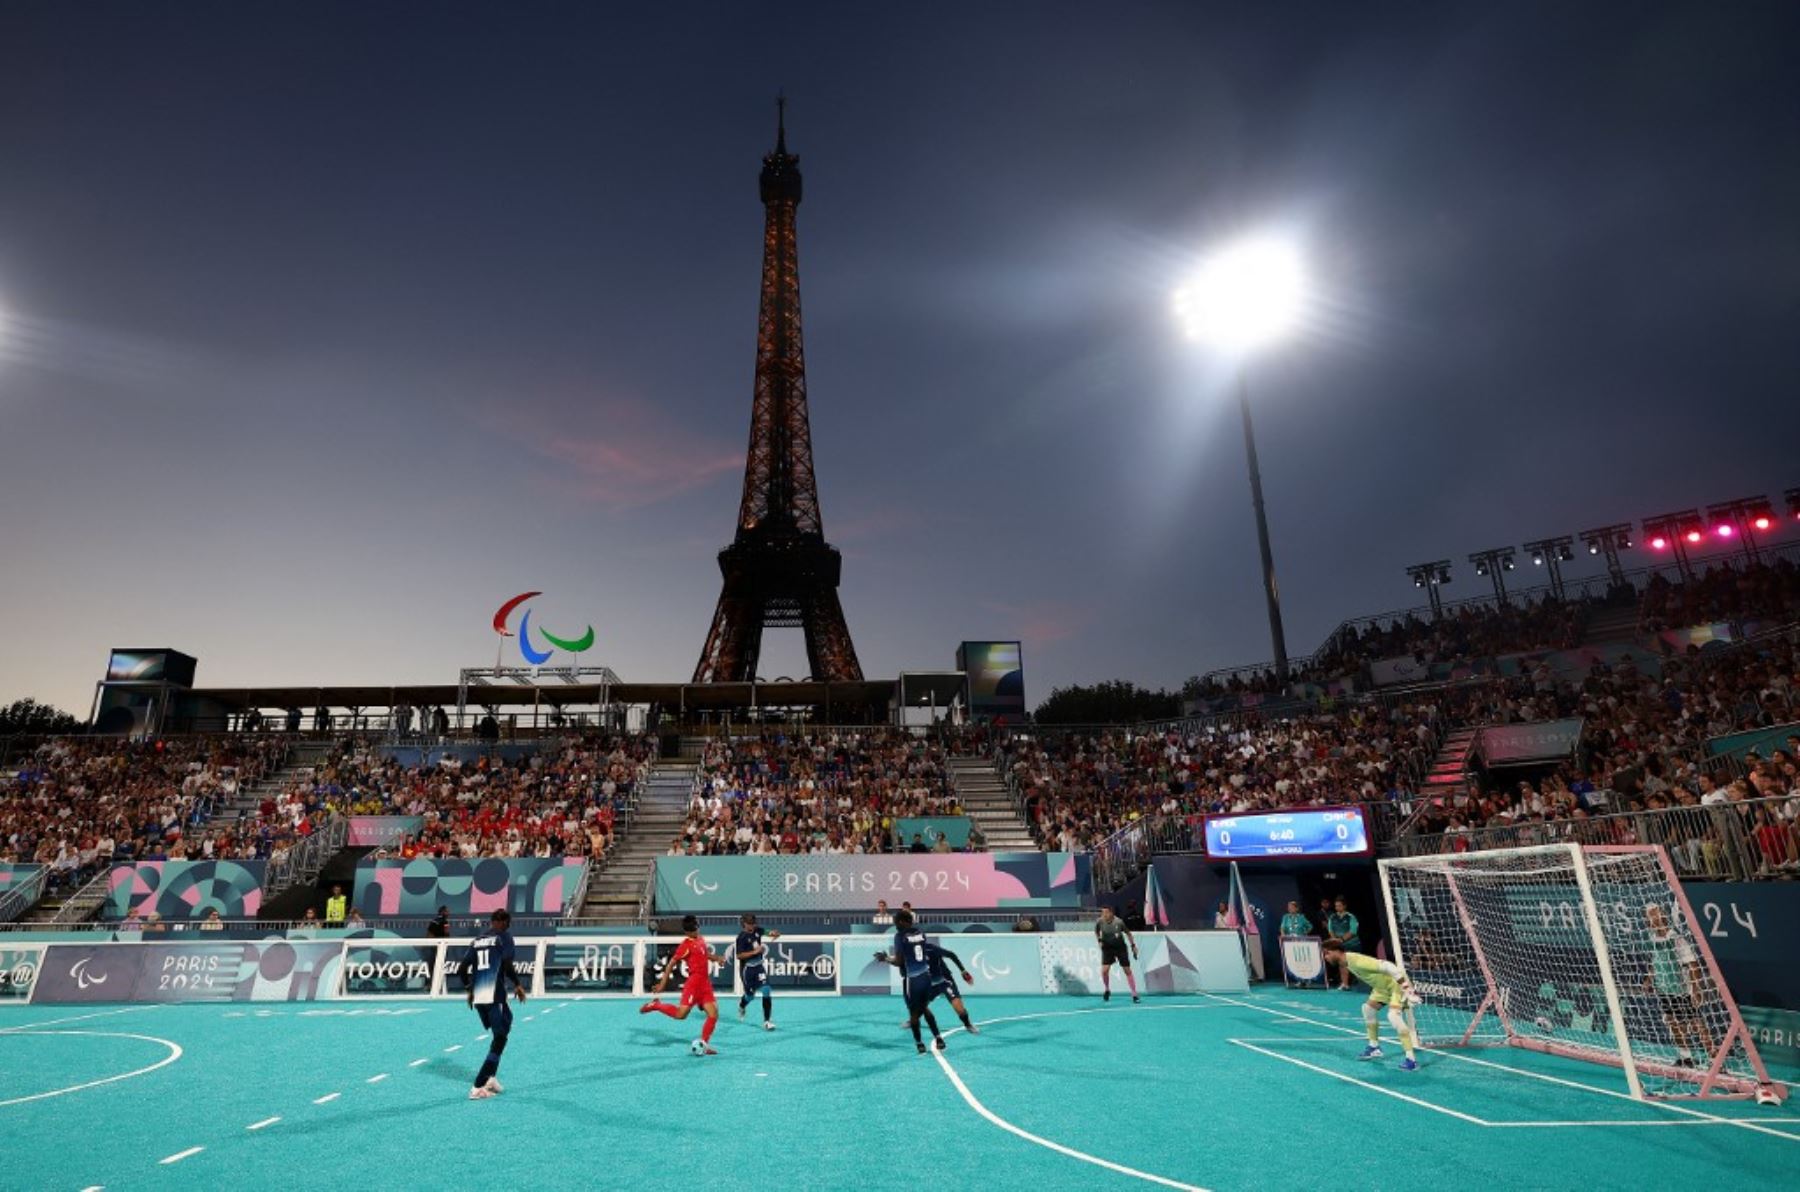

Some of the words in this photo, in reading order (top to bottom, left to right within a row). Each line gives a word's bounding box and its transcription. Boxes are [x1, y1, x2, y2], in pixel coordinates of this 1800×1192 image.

[1221, 831, 1231, 845] 0
[1270, 829, 1294, 841] 6:40
[1336, 823, 1348, 840] 0
[889, 871, 969, 891] 2024
[477, 949, 490, 970] 11
[346, 961, 430, 979] TOYOTA
[158, 973, 214, 990] 2024
